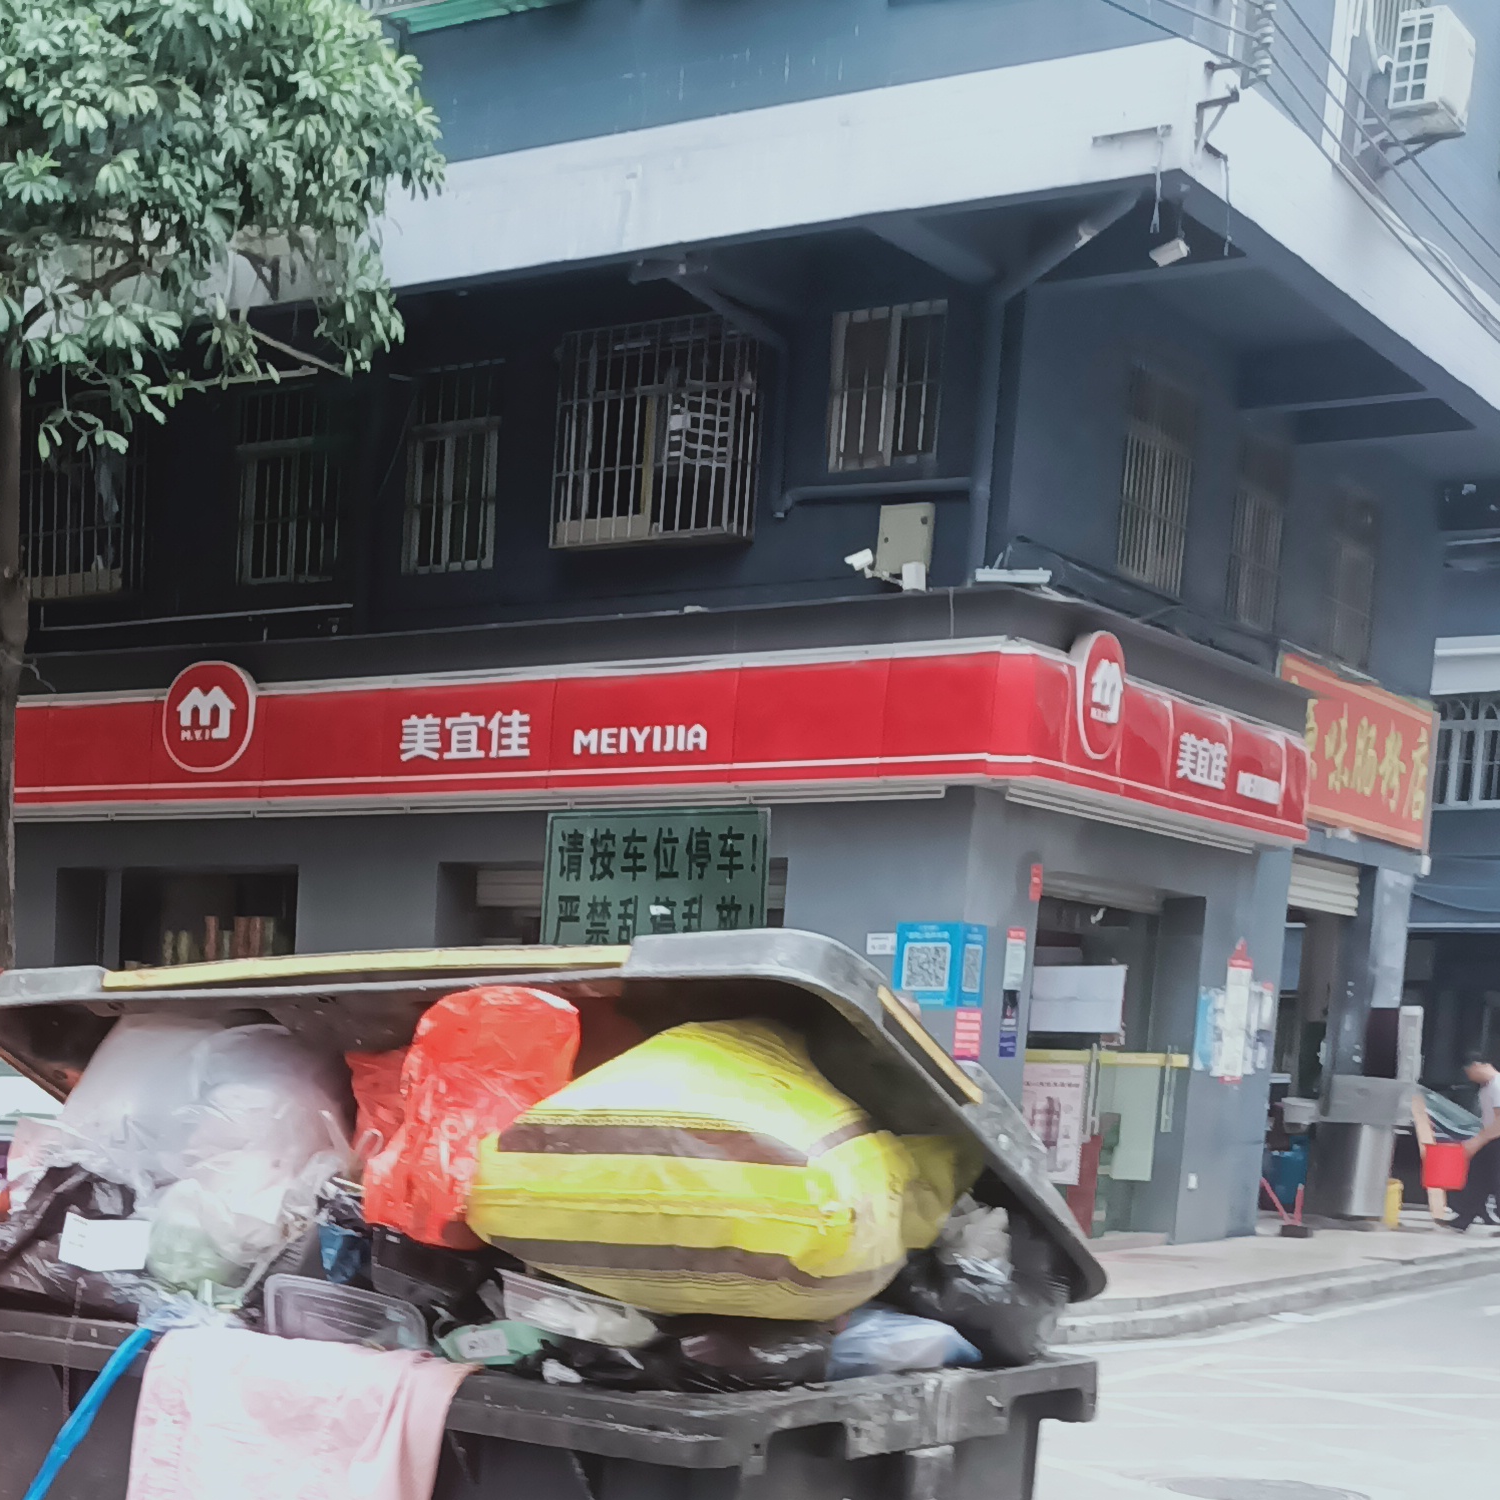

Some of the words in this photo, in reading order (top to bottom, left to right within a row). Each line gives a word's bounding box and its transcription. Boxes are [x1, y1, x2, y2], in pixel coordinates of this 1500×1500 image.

[400, 709, 530, 761] 美宜佳
[573, 723, 708, 755] MEIYIJIA
